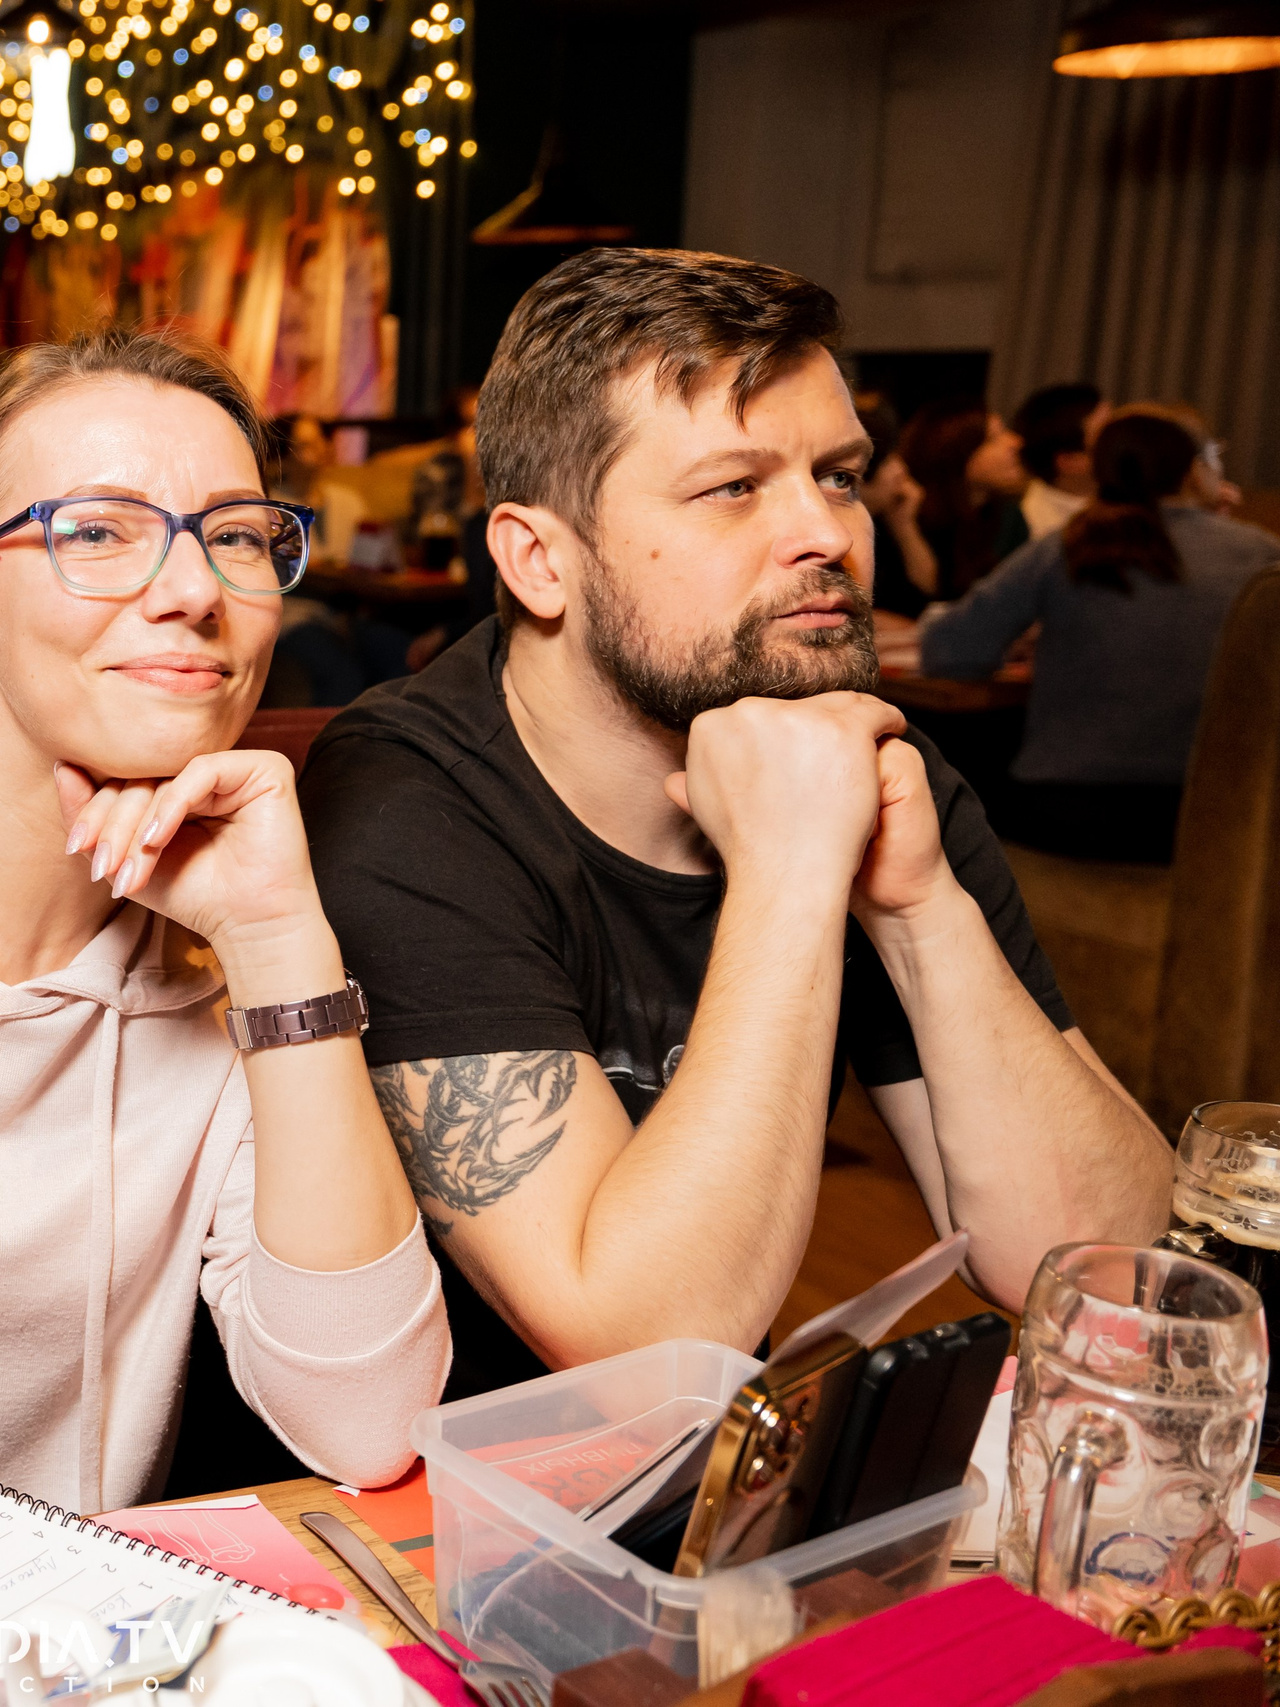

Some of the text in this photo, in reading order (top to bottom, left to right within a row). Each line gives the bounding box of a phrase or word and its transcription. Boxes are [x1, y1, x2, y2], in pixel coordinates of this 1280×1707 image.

[0, 1511, 13, 1522] 5
[32, 1530, 44, 1539] 4
[67, 1545, 81, 1555] 3
[101, 1563, 117, 1573] 2
[138, 1581, 153, 1590] 1
